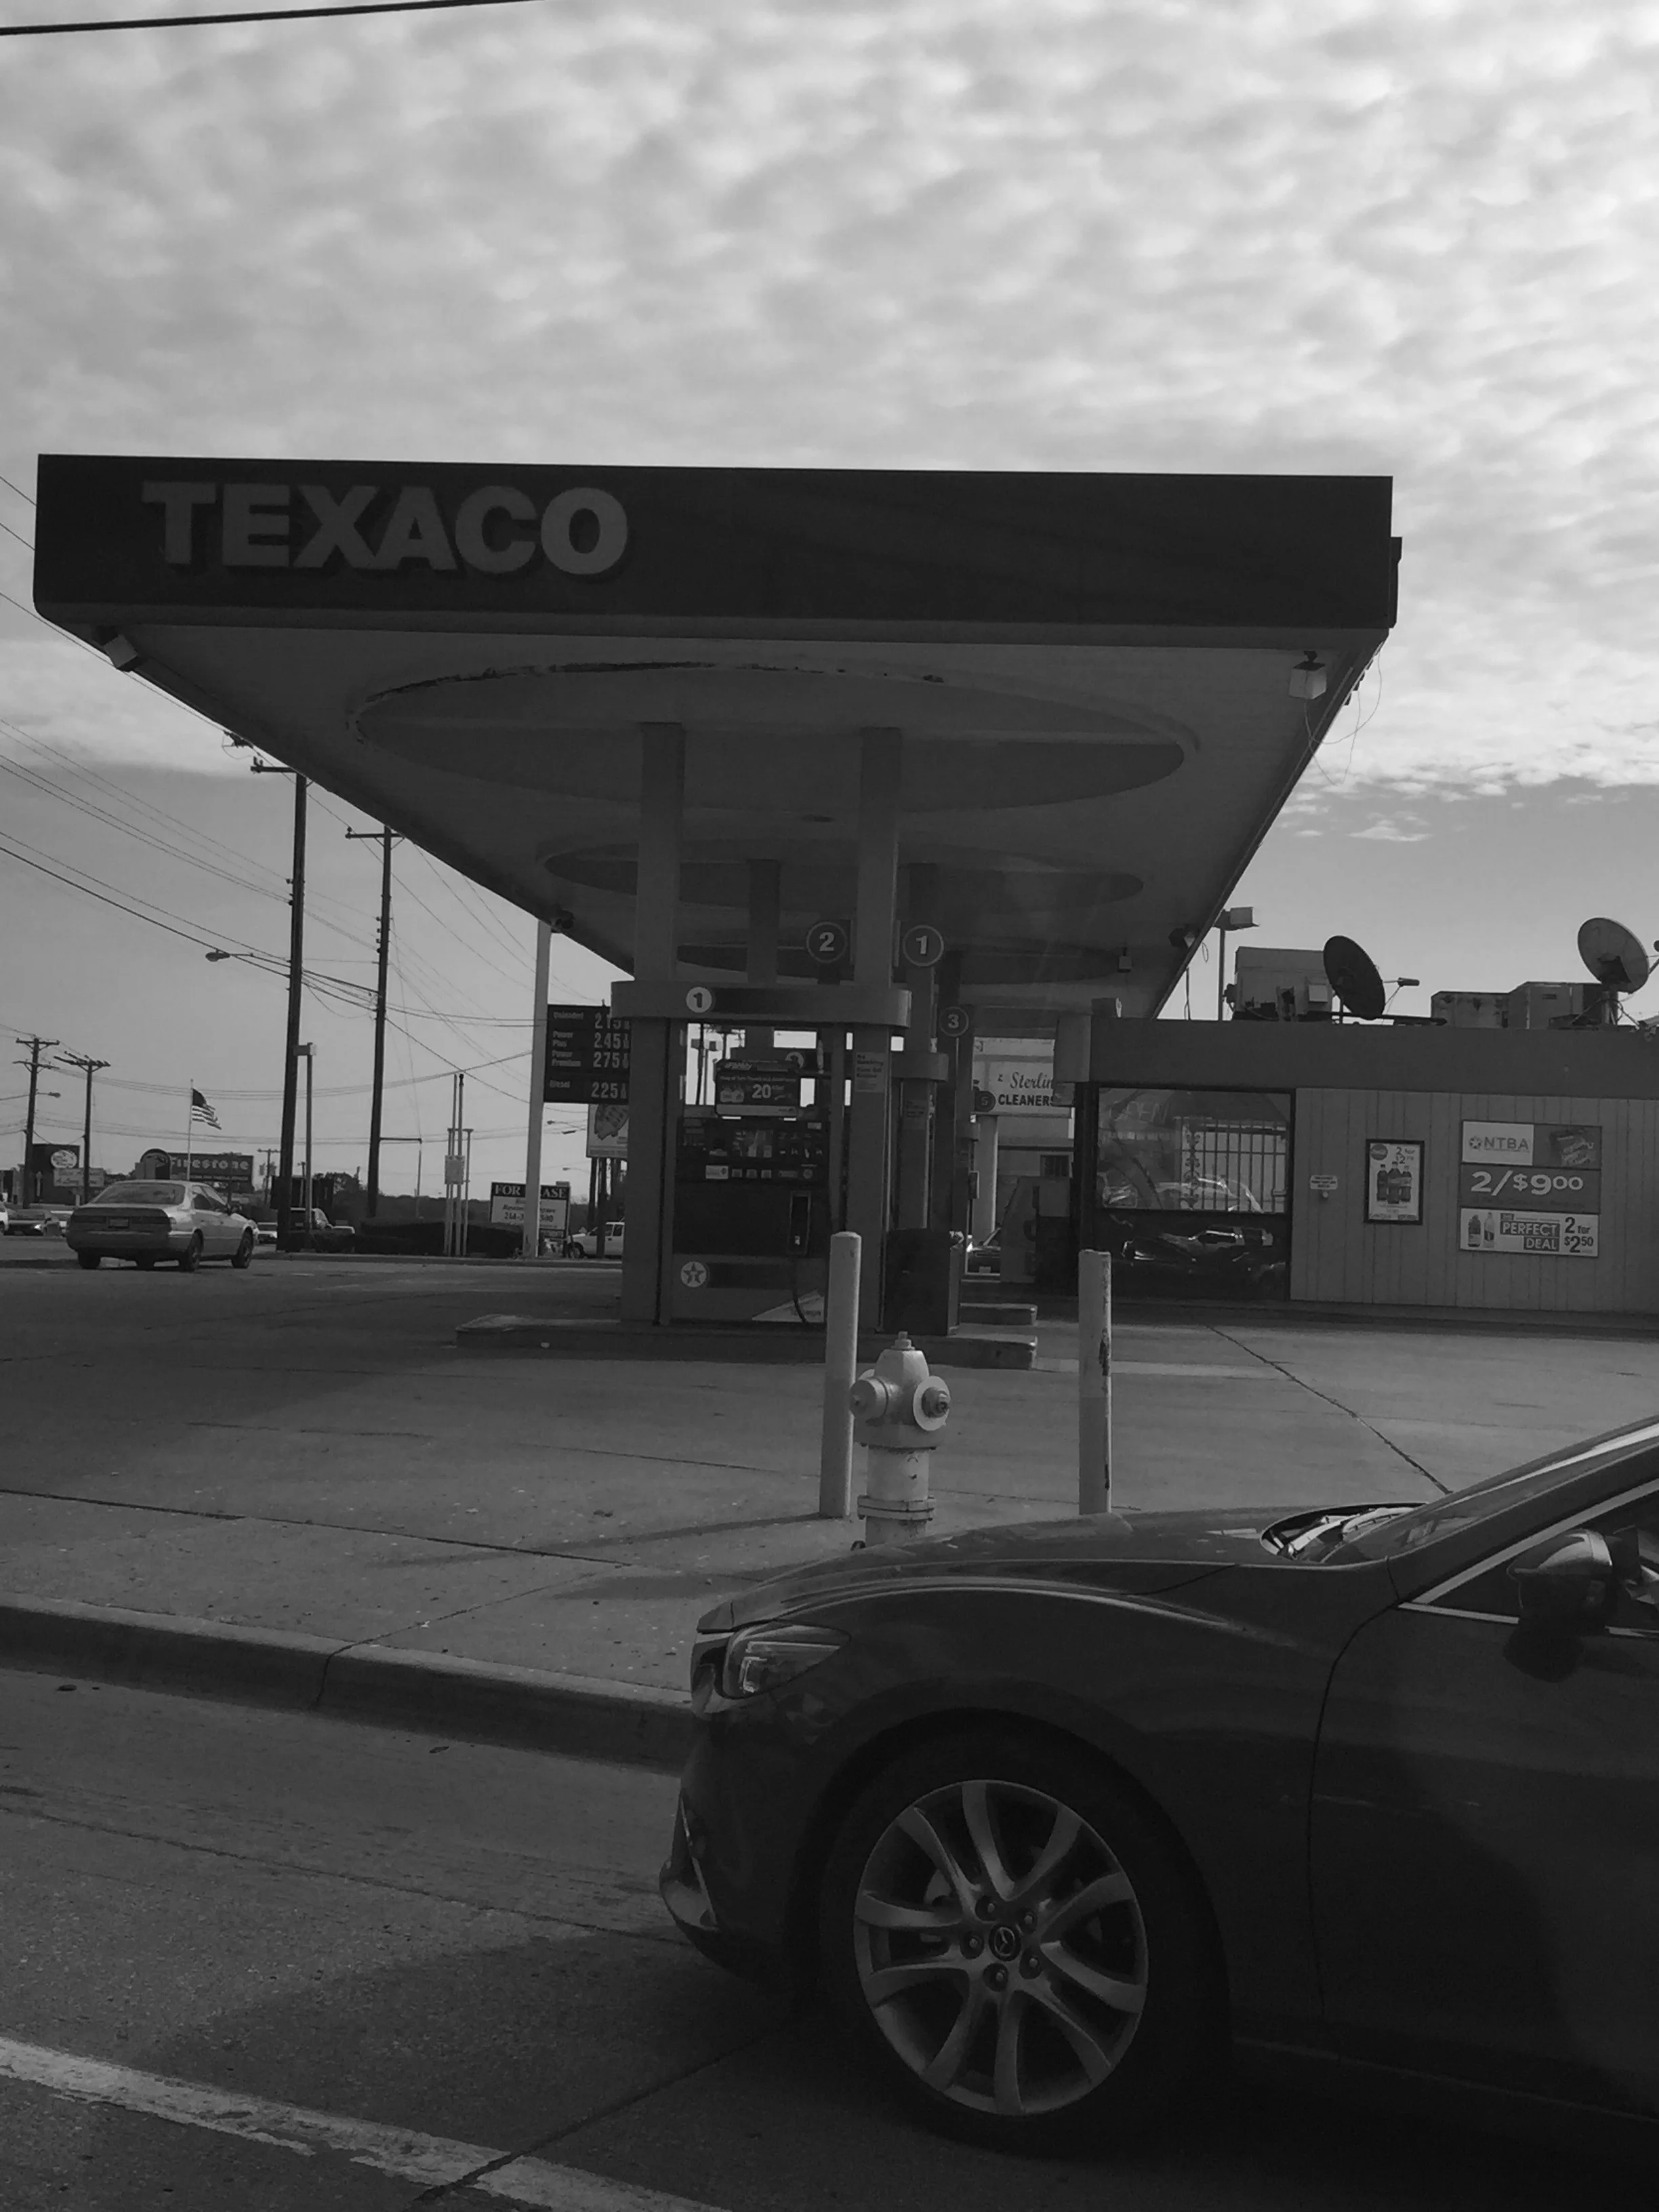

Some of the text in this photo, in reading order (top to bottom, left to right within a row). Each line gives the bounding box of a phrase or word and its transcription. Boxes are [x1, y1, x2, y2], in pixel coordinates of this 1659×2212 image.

[141, 480, 629, 576] TEXACO
[819, 932, 834, 951] 2
[916, 935, 928, 955] 1
[693, 992, 703, 1008] 1
[947, 1014, 960, 1028] 3
[594, 1032, 621, 1049] 245
[593, 1051, 620, 1068] 275
[1009, 1071, 1054, 1090] Sterlin
[591, 1082, 619, 1099] 225
[752, 1084, 772, 1099] 20
[1483, 1136, 1530, 1150] NTBA
[495, 1185, 569, 1199] FOR ASE
[1502, 1222, 1559, 1236] PERFECT
[1565, 1217, 1576, 1234] 2
[1578, 1225, 1591, 1234] for
[1525, 1237, 1559, 1250] DEAL
